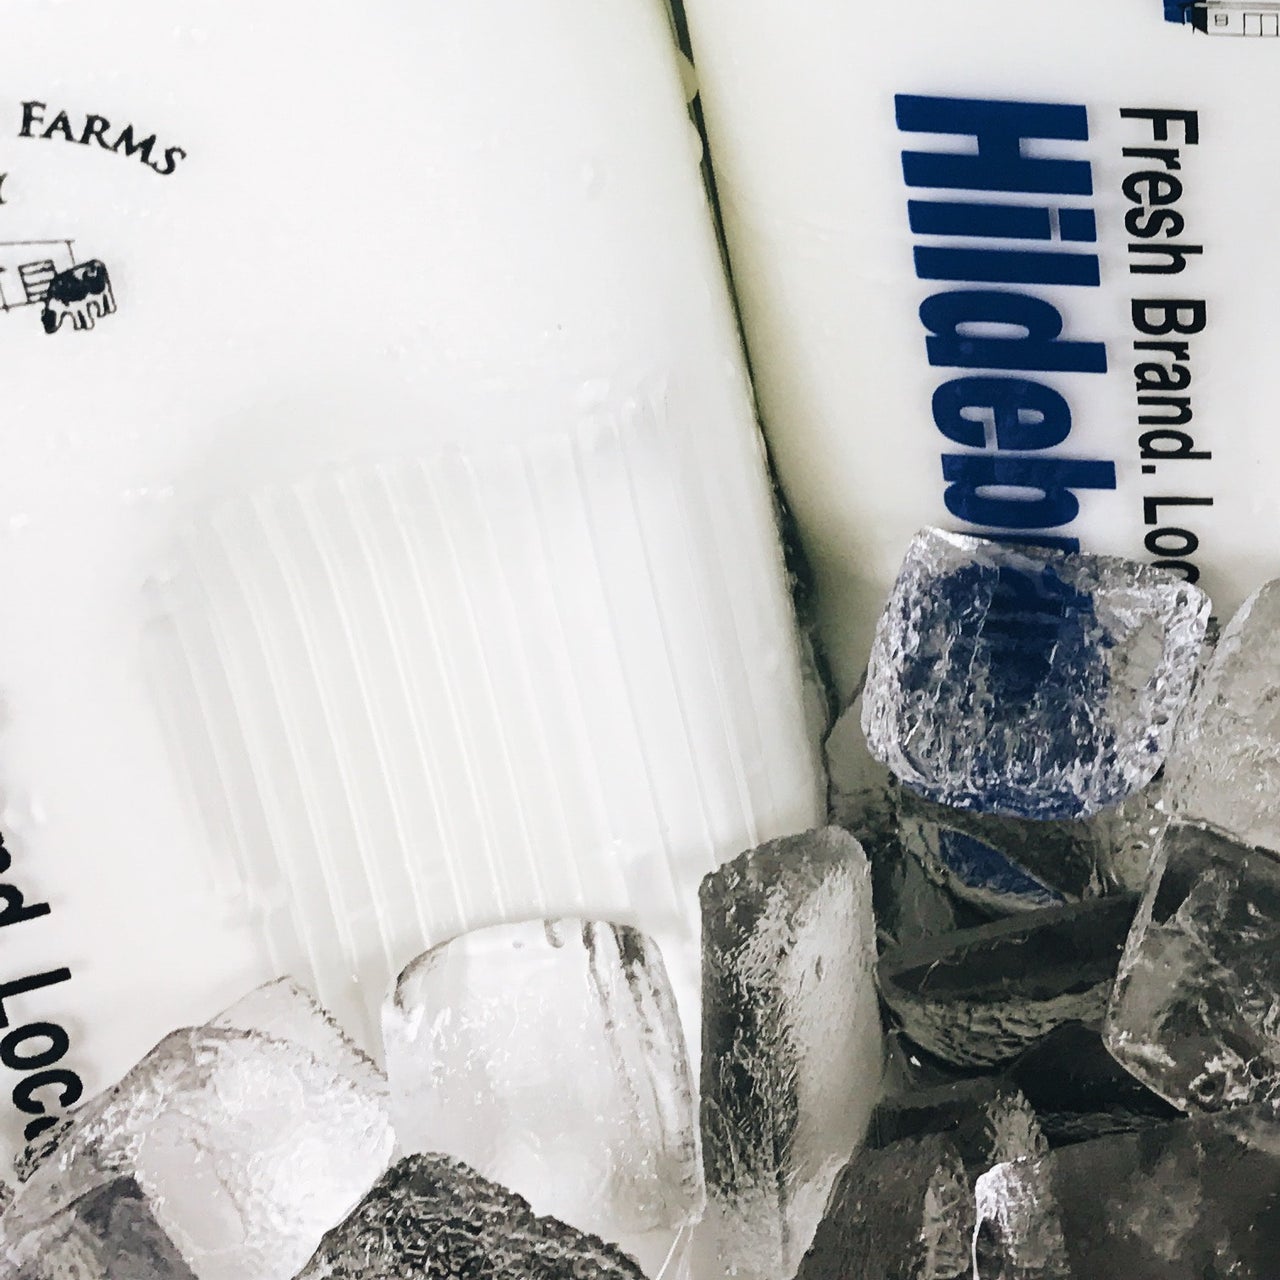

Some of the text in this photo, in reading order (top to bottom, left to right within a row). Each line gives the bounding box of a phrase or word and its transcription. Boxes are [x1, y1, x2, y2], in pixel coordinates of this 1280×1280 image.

[18, 100, 188, 176] FARMS
[1119, 106, 1204, 275] Fresh
[1130, 298, 1213, 474] Brand.
